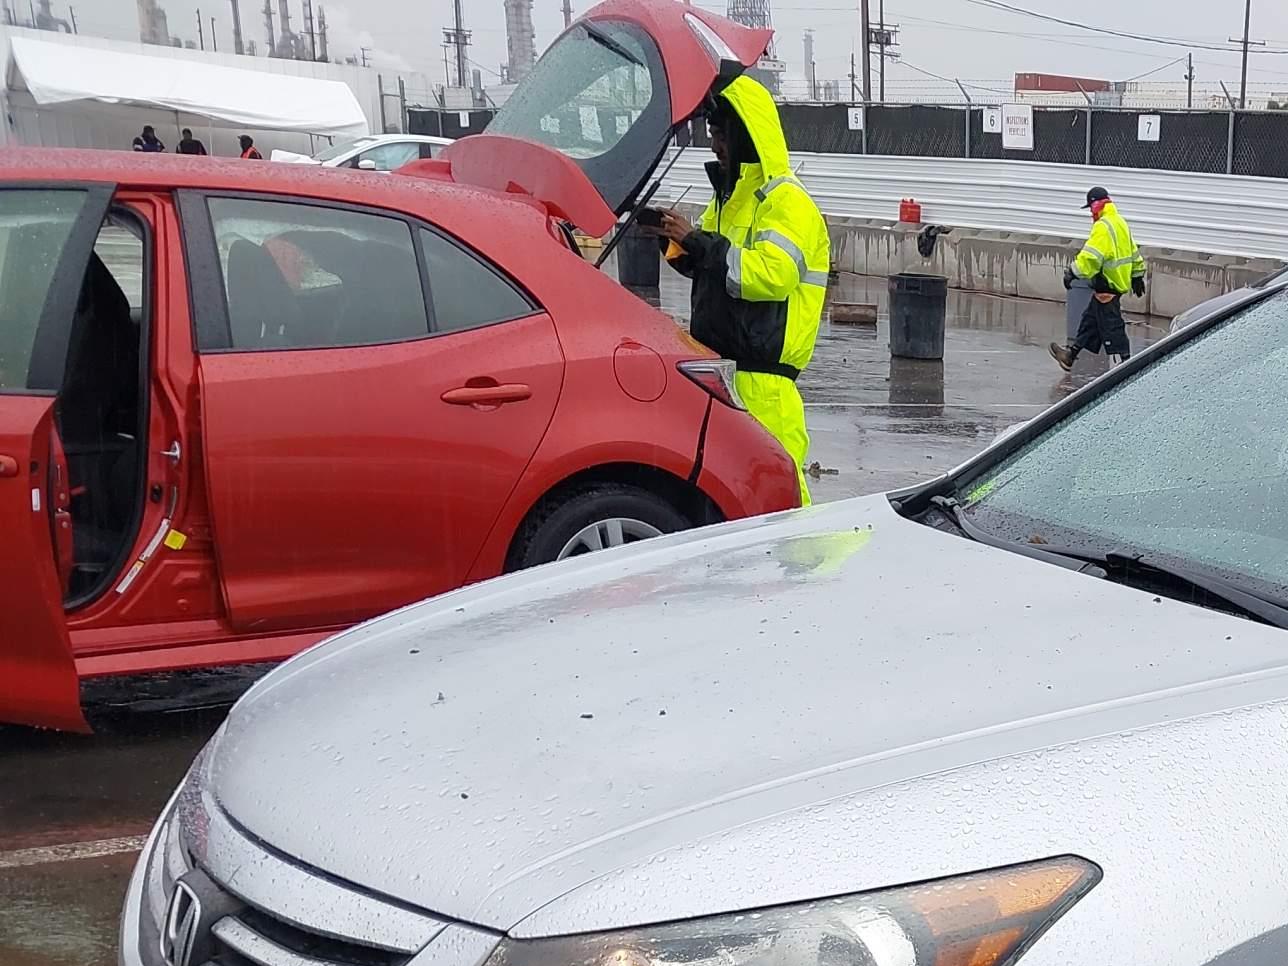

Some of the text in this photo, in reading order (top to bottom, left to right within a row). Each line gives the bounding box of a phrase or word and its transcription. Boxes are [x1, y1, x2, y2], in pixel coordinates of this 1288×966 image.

[854, 112, 859, 124] 5
[989, 115, 995, 127] 6
[1146, 121, 1152, 135] 7
